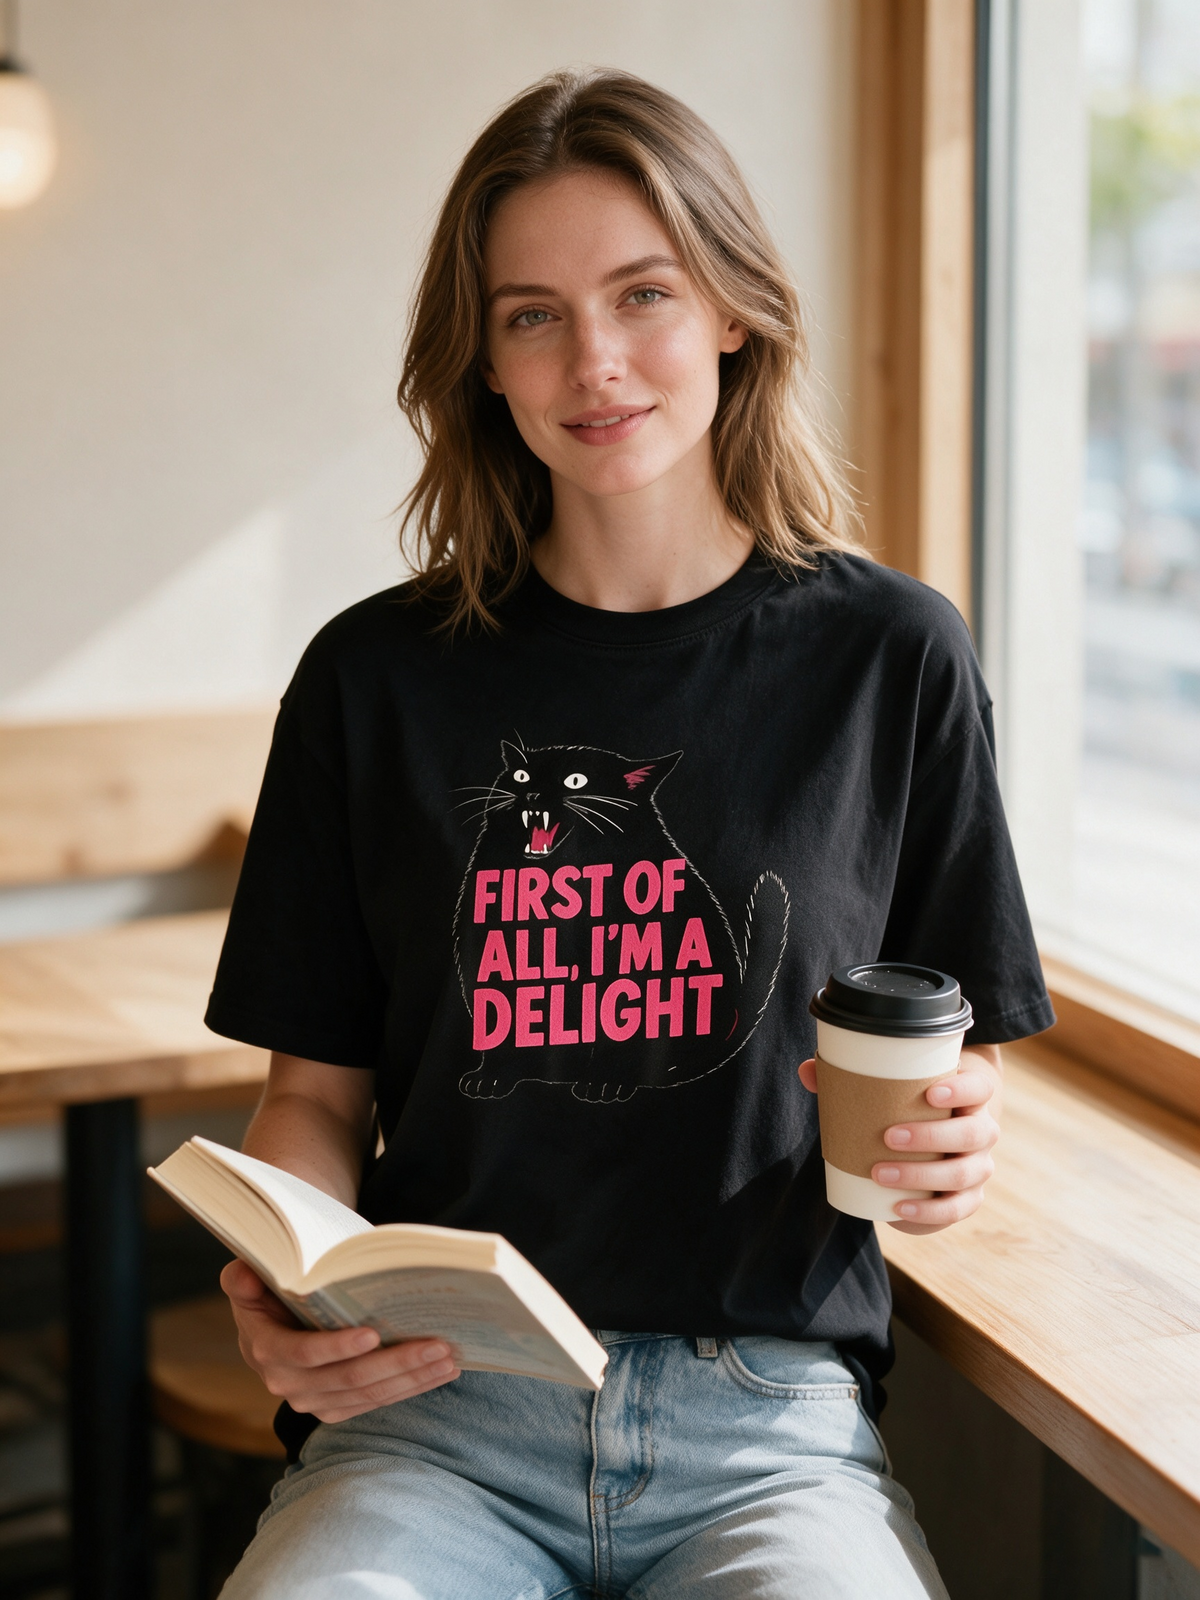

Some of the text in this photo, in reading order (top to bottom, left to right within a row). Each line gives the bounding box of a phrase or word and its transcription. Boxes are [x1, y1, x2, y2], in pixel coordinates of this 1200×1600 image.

[474, 859, 686, 923] FIRST OF
[477, 918, 712, 982] ALL, I'M A
[473, 974, 723, 1050] DELIGHT
